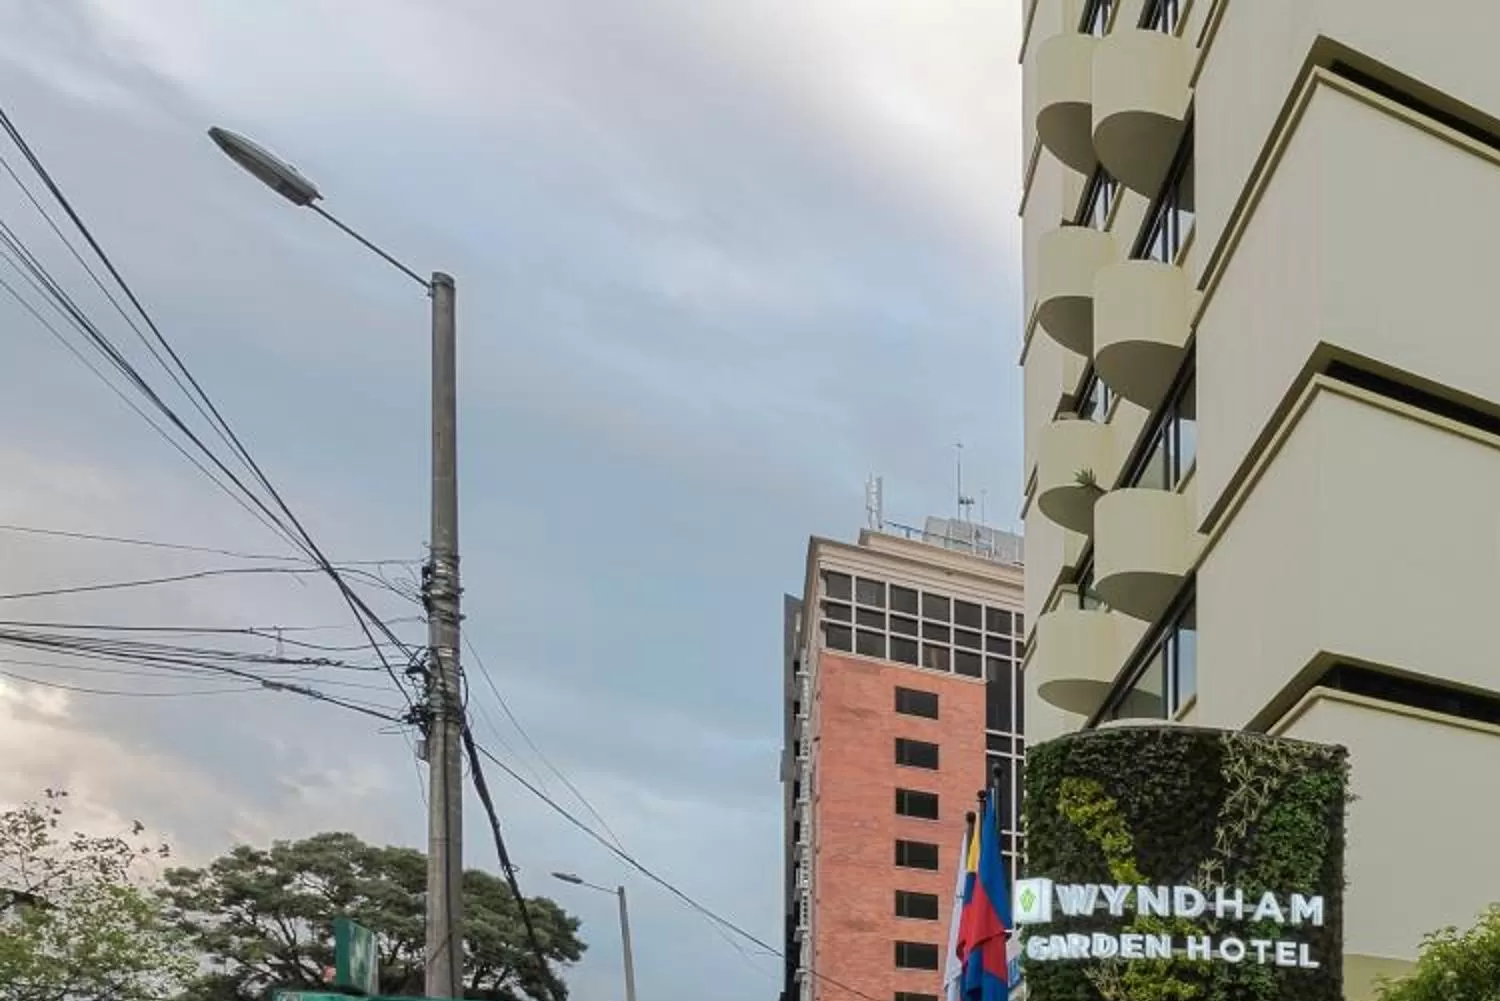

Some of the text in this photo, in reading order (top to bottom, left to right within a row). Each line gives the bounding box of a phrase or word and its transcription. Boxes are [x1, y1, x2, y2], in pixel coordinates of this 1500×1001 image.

[1055, 883, 1325, 927] WYNDHAM
[1027, 932, 1321, 969] GARDEN HOTEL
